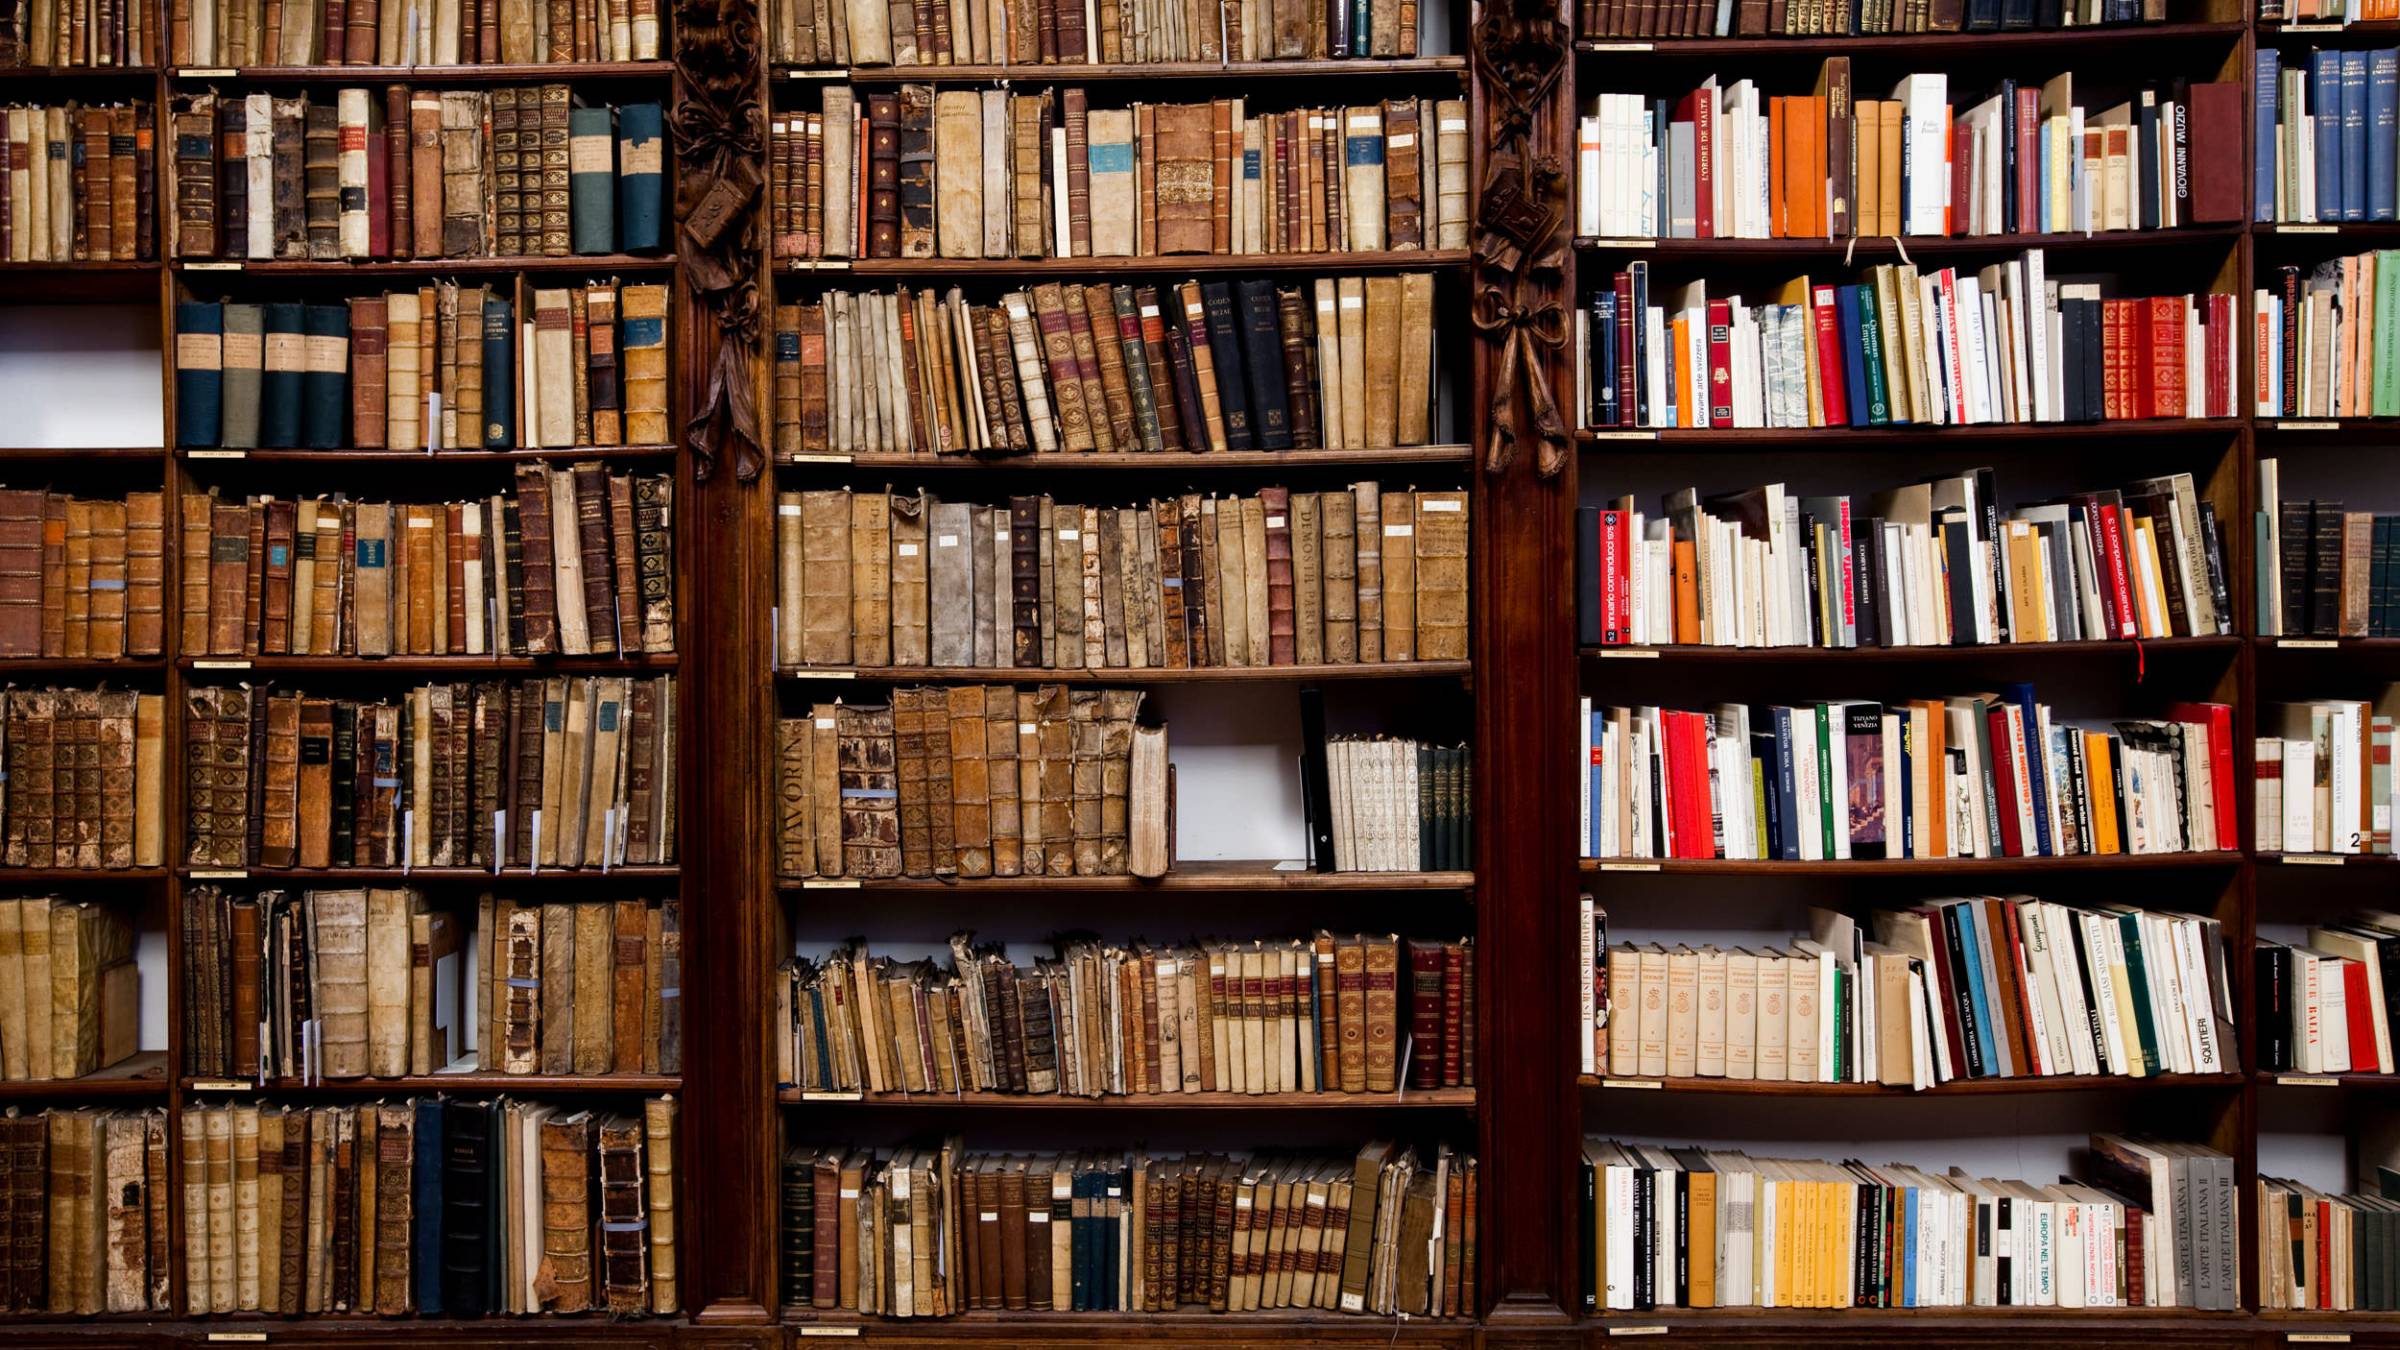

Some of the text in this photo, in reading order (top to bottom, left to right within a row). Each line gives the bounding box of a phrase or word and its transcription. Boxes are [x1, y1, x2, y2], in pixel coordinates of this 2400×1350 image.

[1700, 97, 1709, 181] L'ORDRE DE MALTE
[2176, 105, 2187, 198] GIOVANNI MUZIO
[1695, 338, 1703, 371] svizzera
[1861, 319, 1878, 358] Ottoman Empire
[2259, 322, 2267, 392] DANISH MUSEUMS
[1696, 392, 1705, 426] Giovane
[1300, 511, 1315, 584] DEMOSTH
[2111, 534, 2125, 585] comanducci
[1606, 526, 1615, 630] annuario comanducci 1975
[2118, 586, 2131, 622] annuario
[1781, 716, 1789, 749] SALVATOR
[2018, 744, 2025, 753] DI
[2019, 755, 2031, 803] COLLEZIONE
[2071, 730, 2089, 852] leonard freed black in white america
[2025, 806, 2033, 816] LA
[2038, 810, 2046, 822] ART
[2350, 832, 2361, 848] 2
[1582, 909, 1590, 953] BUDAPEST
[1582, 956, 1590, 966] DE
[1962, 991, 1980, 1067] LOMBARDIA SULL'ACQUA
[2090, 1009, 2100, 1033] VITALI
[2197, 1018, 2213, 1064] SQUITIERI
[2178, 1187, 2188, 1240] ITALIANA
[2199, 1188, 2209, 1242] ITALIANA
[2219, 1177, 2233, 1291] L'ARTE ITALIANA III
[2040, 1212, 2049, 1295] EUROPA NEL TEMPO
[2181, 1243, 2192, 1287] L'ARTE
[2200, 1245, 2211, 1289] L'ARTE
